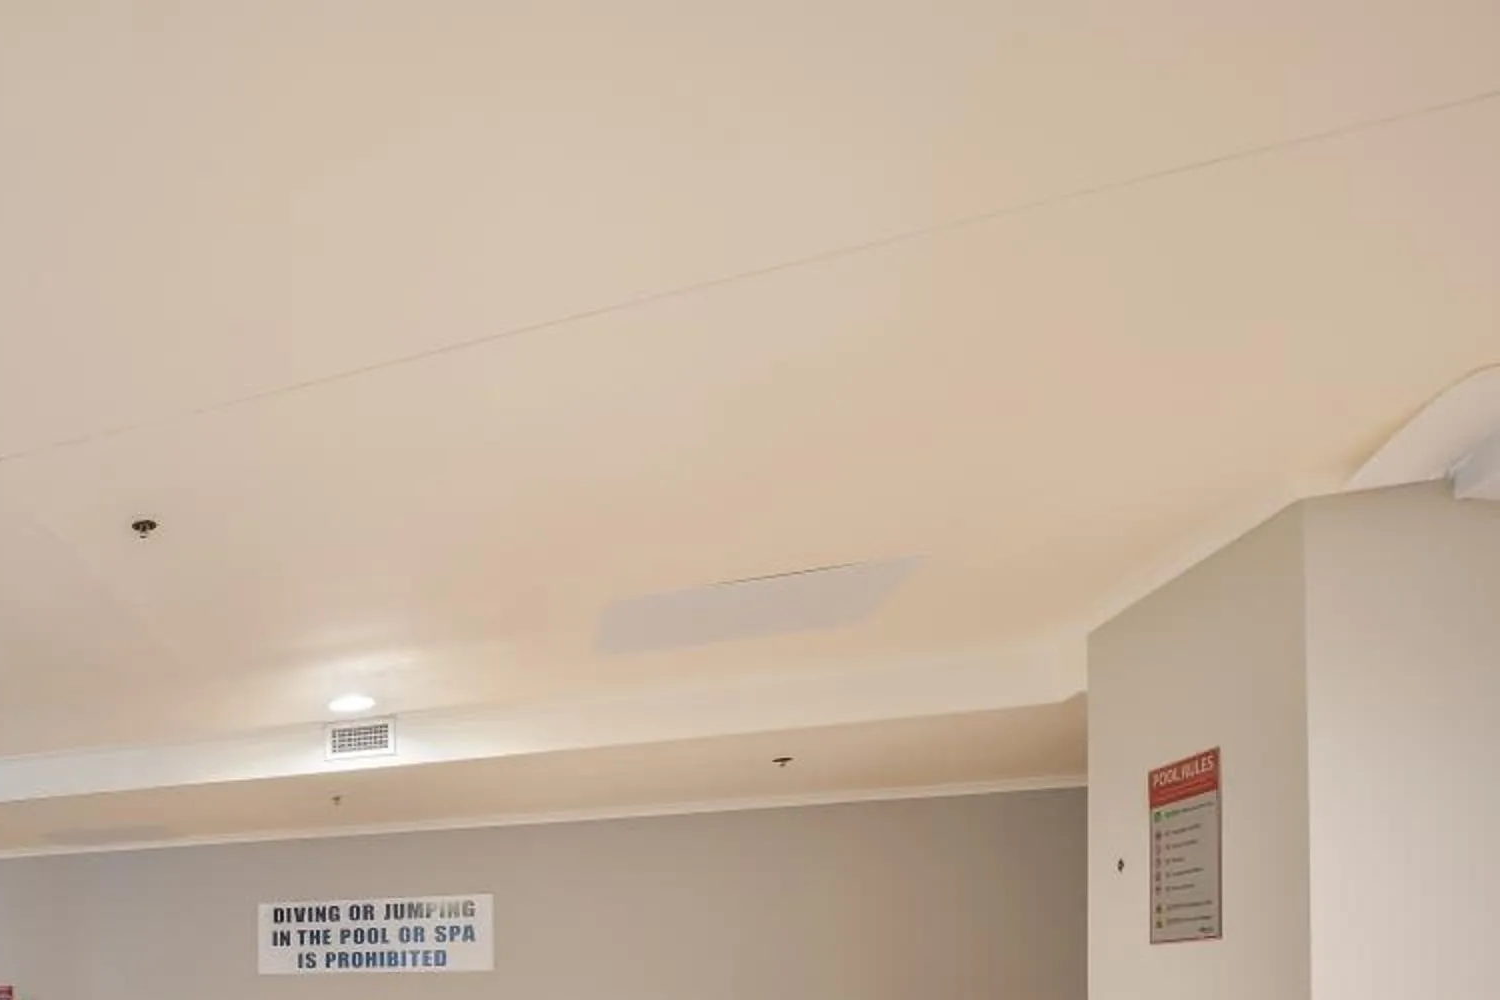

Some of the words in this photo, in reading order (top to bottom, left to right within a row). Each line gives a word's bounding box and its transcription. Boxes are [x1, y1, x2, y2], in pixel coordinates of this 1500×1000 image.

[1153, 767, 1181, 788] POOL
[273, 905, 341, 924] DIVING
[349, 903, 375, 921] OR
[384, 900, 476, 920] JUMPING
[272, 930, 291, 947] IN
[297, 929, 332, 945] THE
[339, 927, 390, 944] POOL
[398, 926, 425, 943] OR
[434, 924, 476, 942] SPA
[298, 951, 317, 969] IS
[325, 949, 447, 969] PROHIBITED
